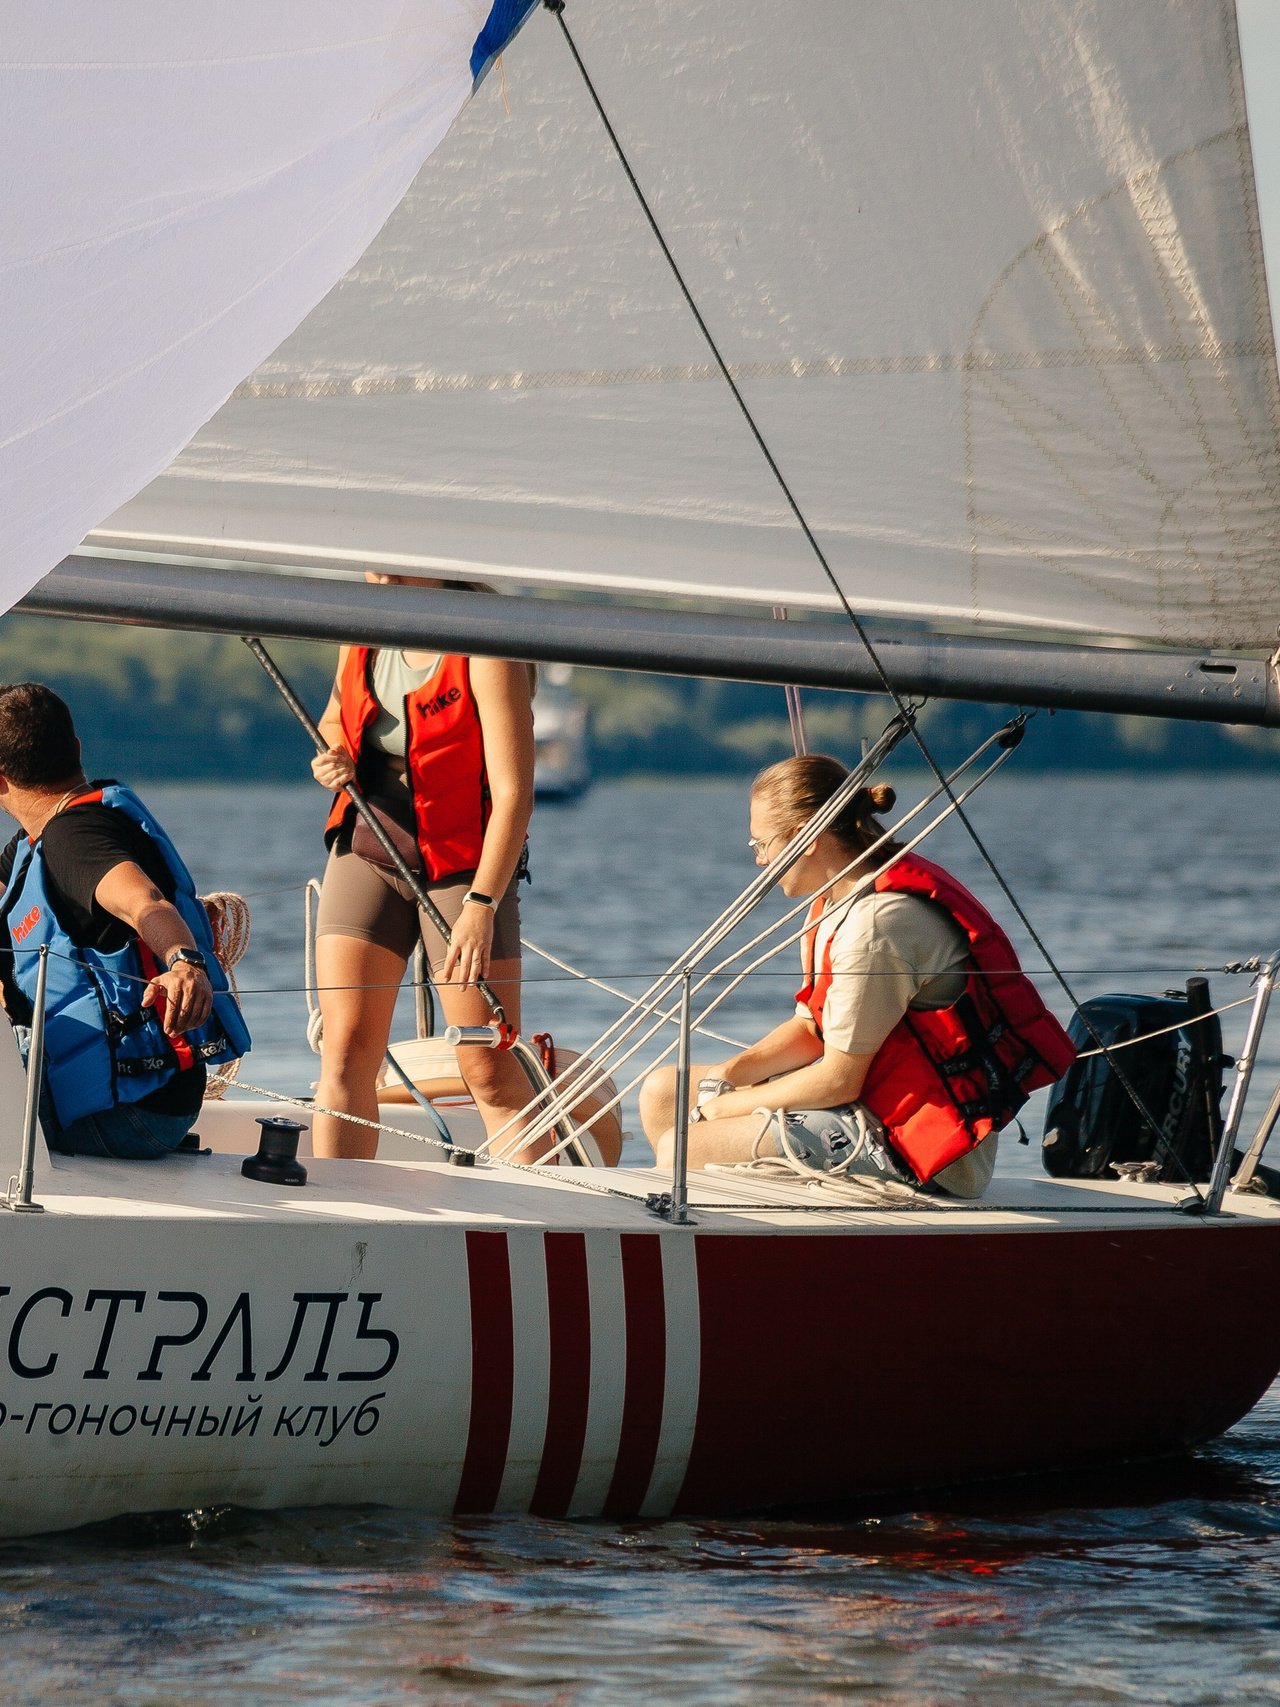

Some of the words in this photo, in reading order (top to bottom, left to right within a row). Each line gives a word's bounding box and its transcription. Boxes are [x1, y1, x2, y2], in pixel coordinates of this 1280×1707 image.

[416, 688, 461, 720] hike
[11, 906, 41, 945] hike
[272, 1391, 388, 1447] клуб
